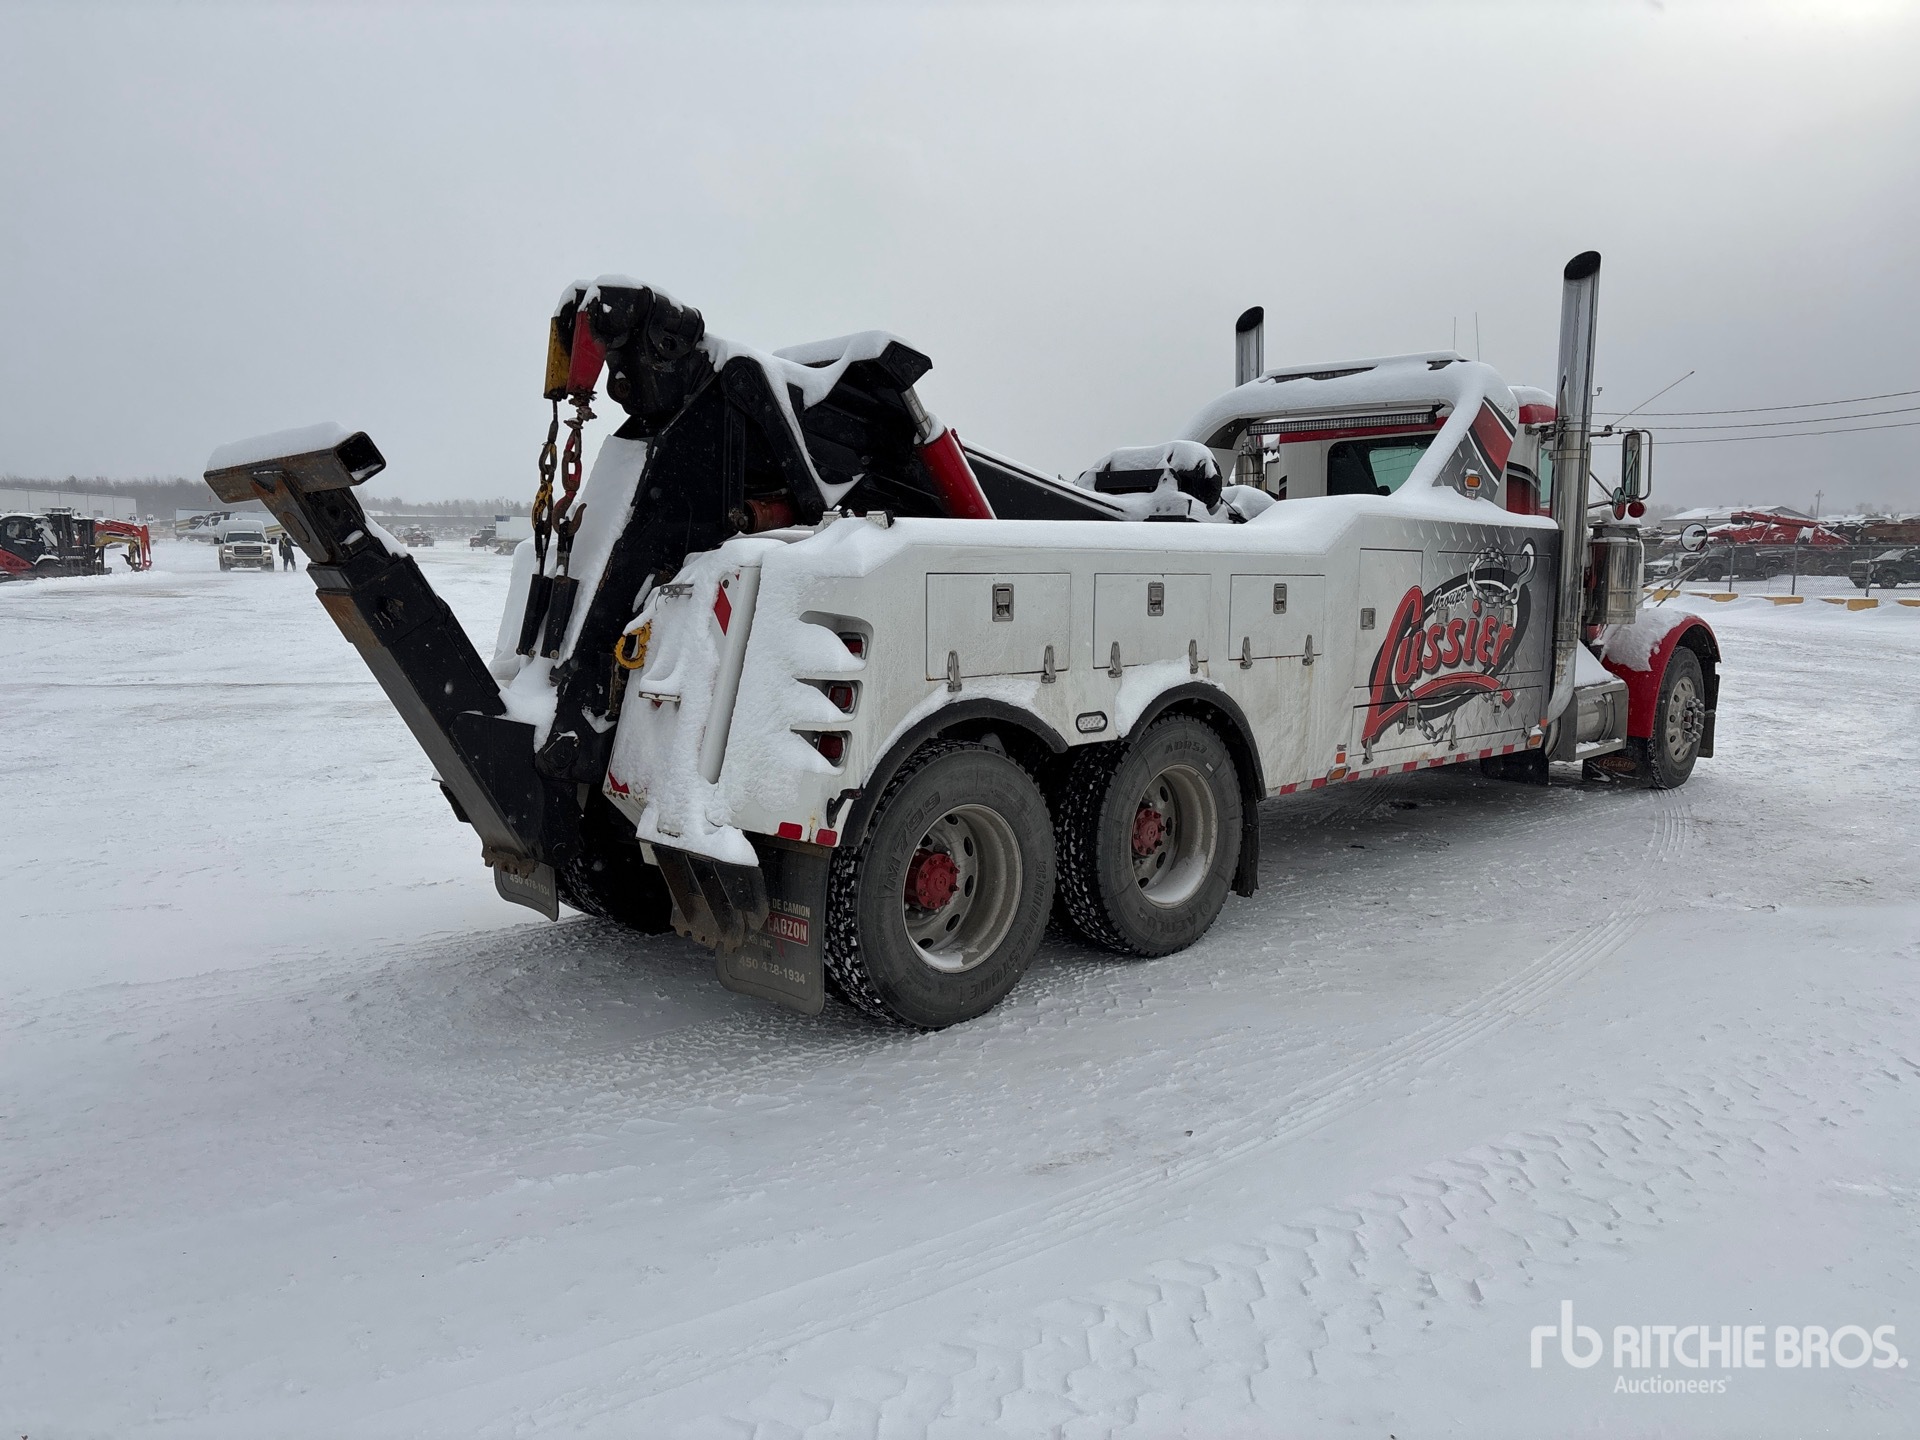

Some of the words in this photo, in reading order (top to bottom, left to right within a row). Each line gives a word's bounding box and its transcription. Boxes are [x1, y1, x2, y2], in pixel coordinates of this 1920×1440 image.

[772, 898, 782, 910] DE
[783, 900, 811, 918] CAMION
[740, 955, 758, 969] 450
[761, 961, 806, 985] 478-1934
